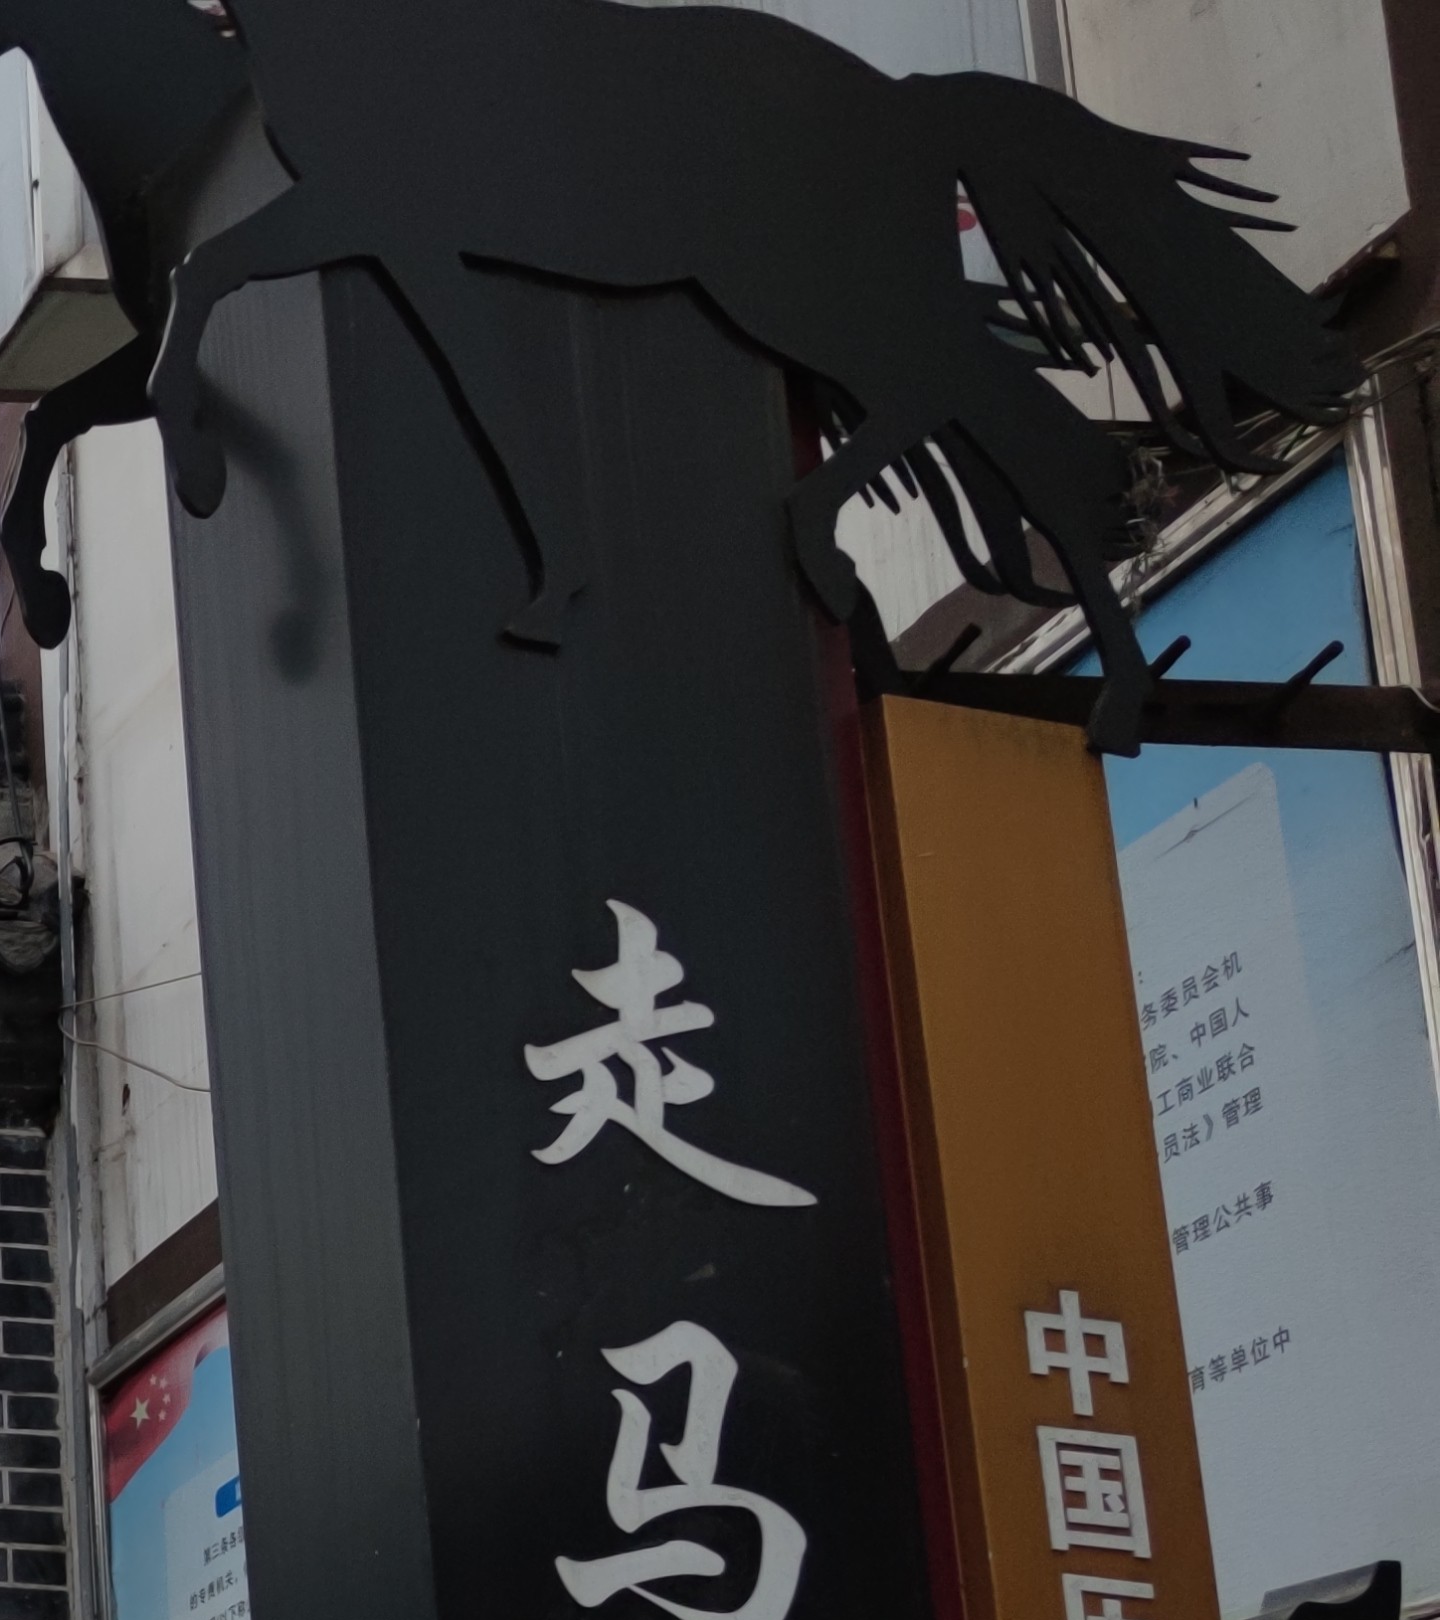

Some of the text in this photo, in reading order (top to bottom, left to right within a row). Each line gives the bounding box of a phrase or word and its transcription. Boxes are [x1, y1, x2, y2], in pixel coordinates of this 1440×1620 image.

[1141, 951, 1243, 1031] 务委员会机
[1149, 997, 1250, 1074] 院、中国人
[1156, 1042, 1255, 1117] 工商业联合
[1164, 1086, 1264, 1164] 员法》管理
[1171, 1180, 1274, 1255] 管理公共事
[1187, 1326, 1291, 1393] 育等单位中
